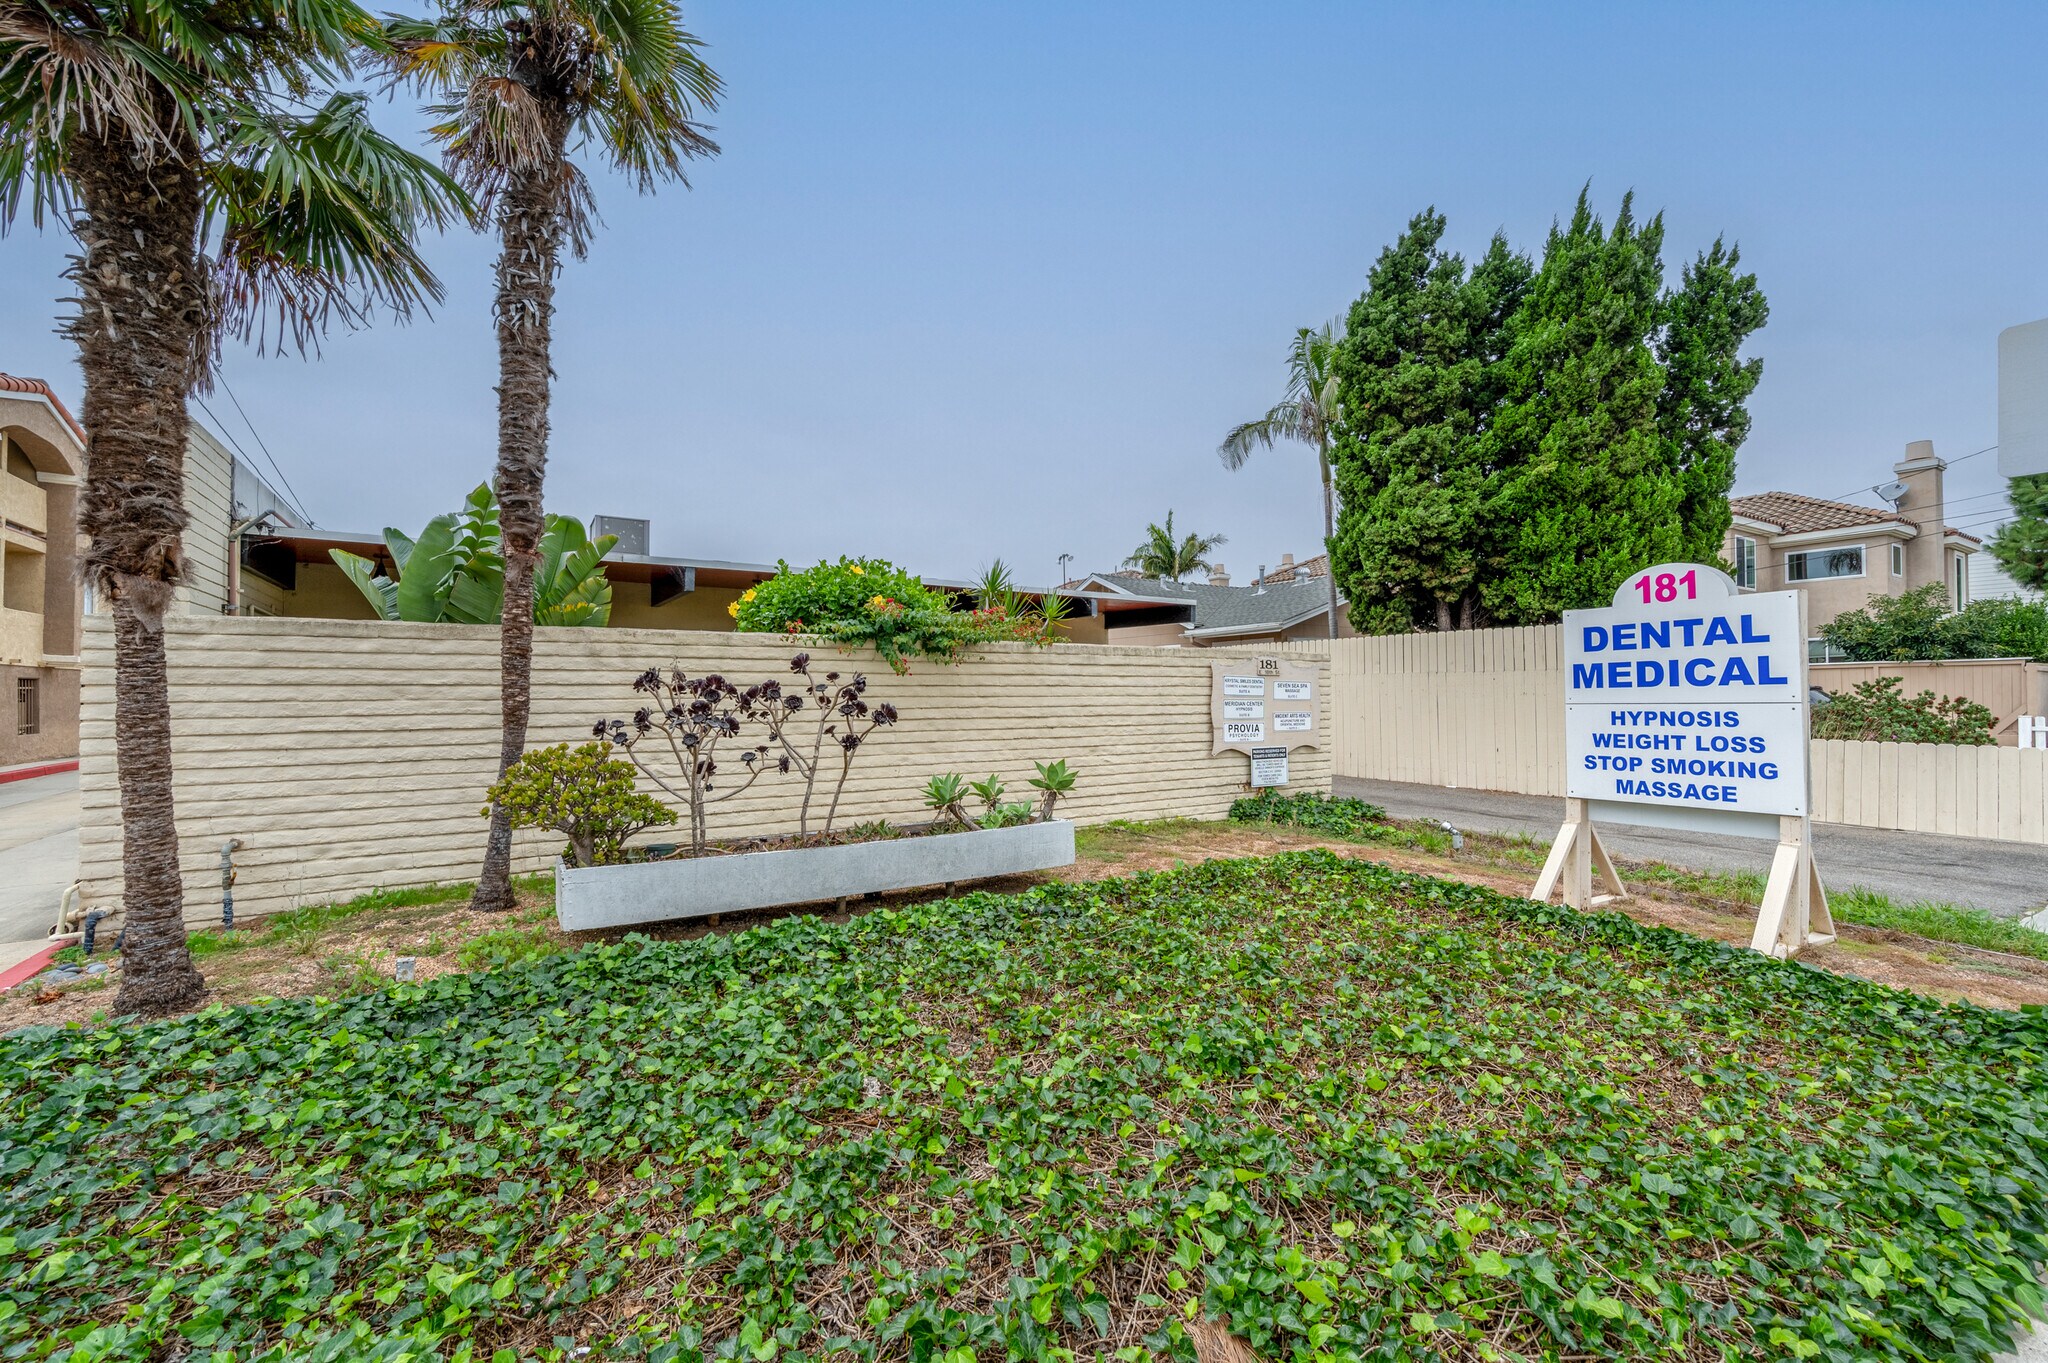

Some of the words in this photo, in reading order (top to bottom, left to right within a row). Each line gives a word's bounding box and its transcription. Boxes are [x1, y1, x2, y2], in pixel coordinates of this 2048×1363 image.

[1635, 569, 1697, 605] 181
[1582, 613, 1771, 653] DENTAL
[1259, 659, 1279, 670] 181
[1572, 655, 1789, 690] MEDICAL
[1227, 723, 1260, 733] PROVIA
[1610, 710, 1740, 728] HYPNOSIS
[1591, 732, 1687, 751] WEIGHT
[1695, 735, 1767, 754] LOSS
[1584, 754, 1643, 773] STOP
[1650, 757, 1779, 781] SMOKING
[1615, 778, 1738, 803] MASSAGE
